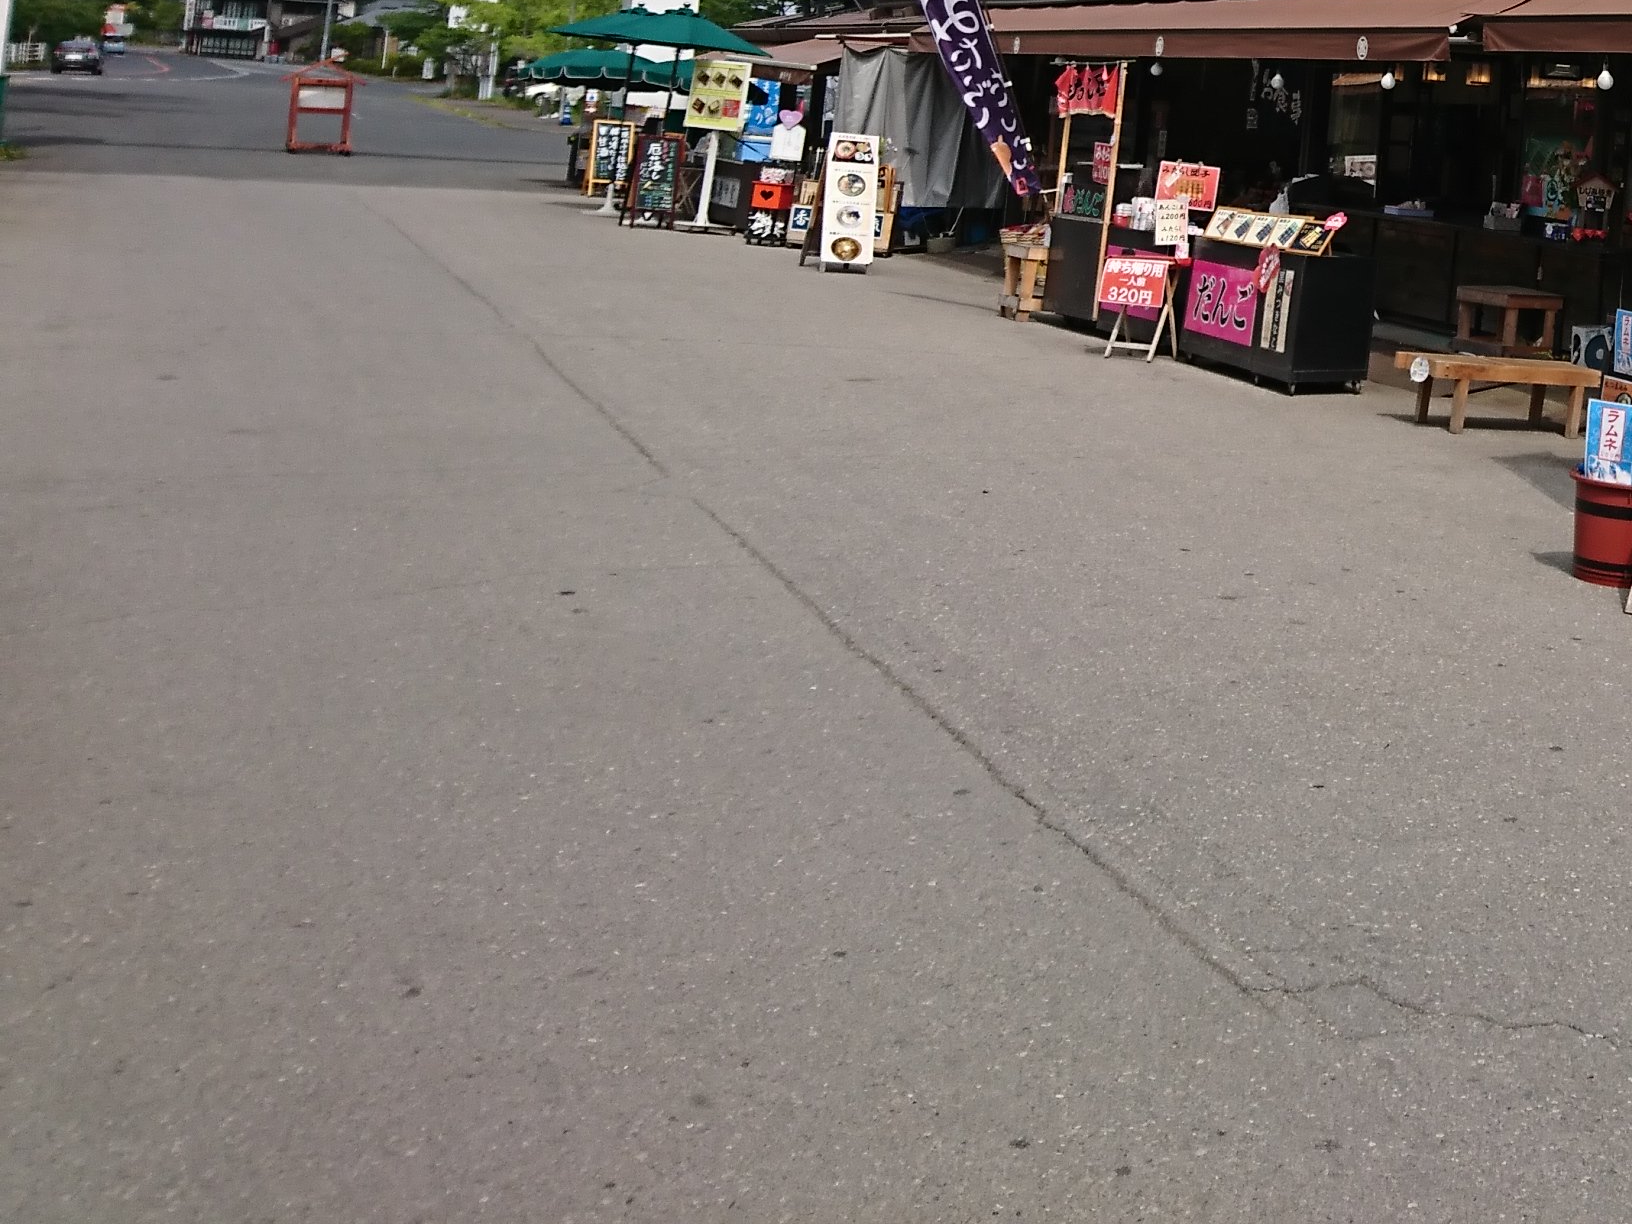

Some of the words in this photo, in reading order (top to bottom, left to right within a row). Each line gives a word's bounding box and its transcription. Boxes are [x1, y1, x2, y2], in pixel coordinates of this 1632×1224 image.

[792, 207, 809, 226] 香
[1107, 260, 1165, 278] 持ち帰り用
[1119, 276, 1147, 287] 一人前
[1107, 286, 1153, 305] 320円
[1193, 274, 1256, 332] だんご
[1622, 315, 1632, 346] ラムネ
[1603, 410, 1622, 456] ラムネ
